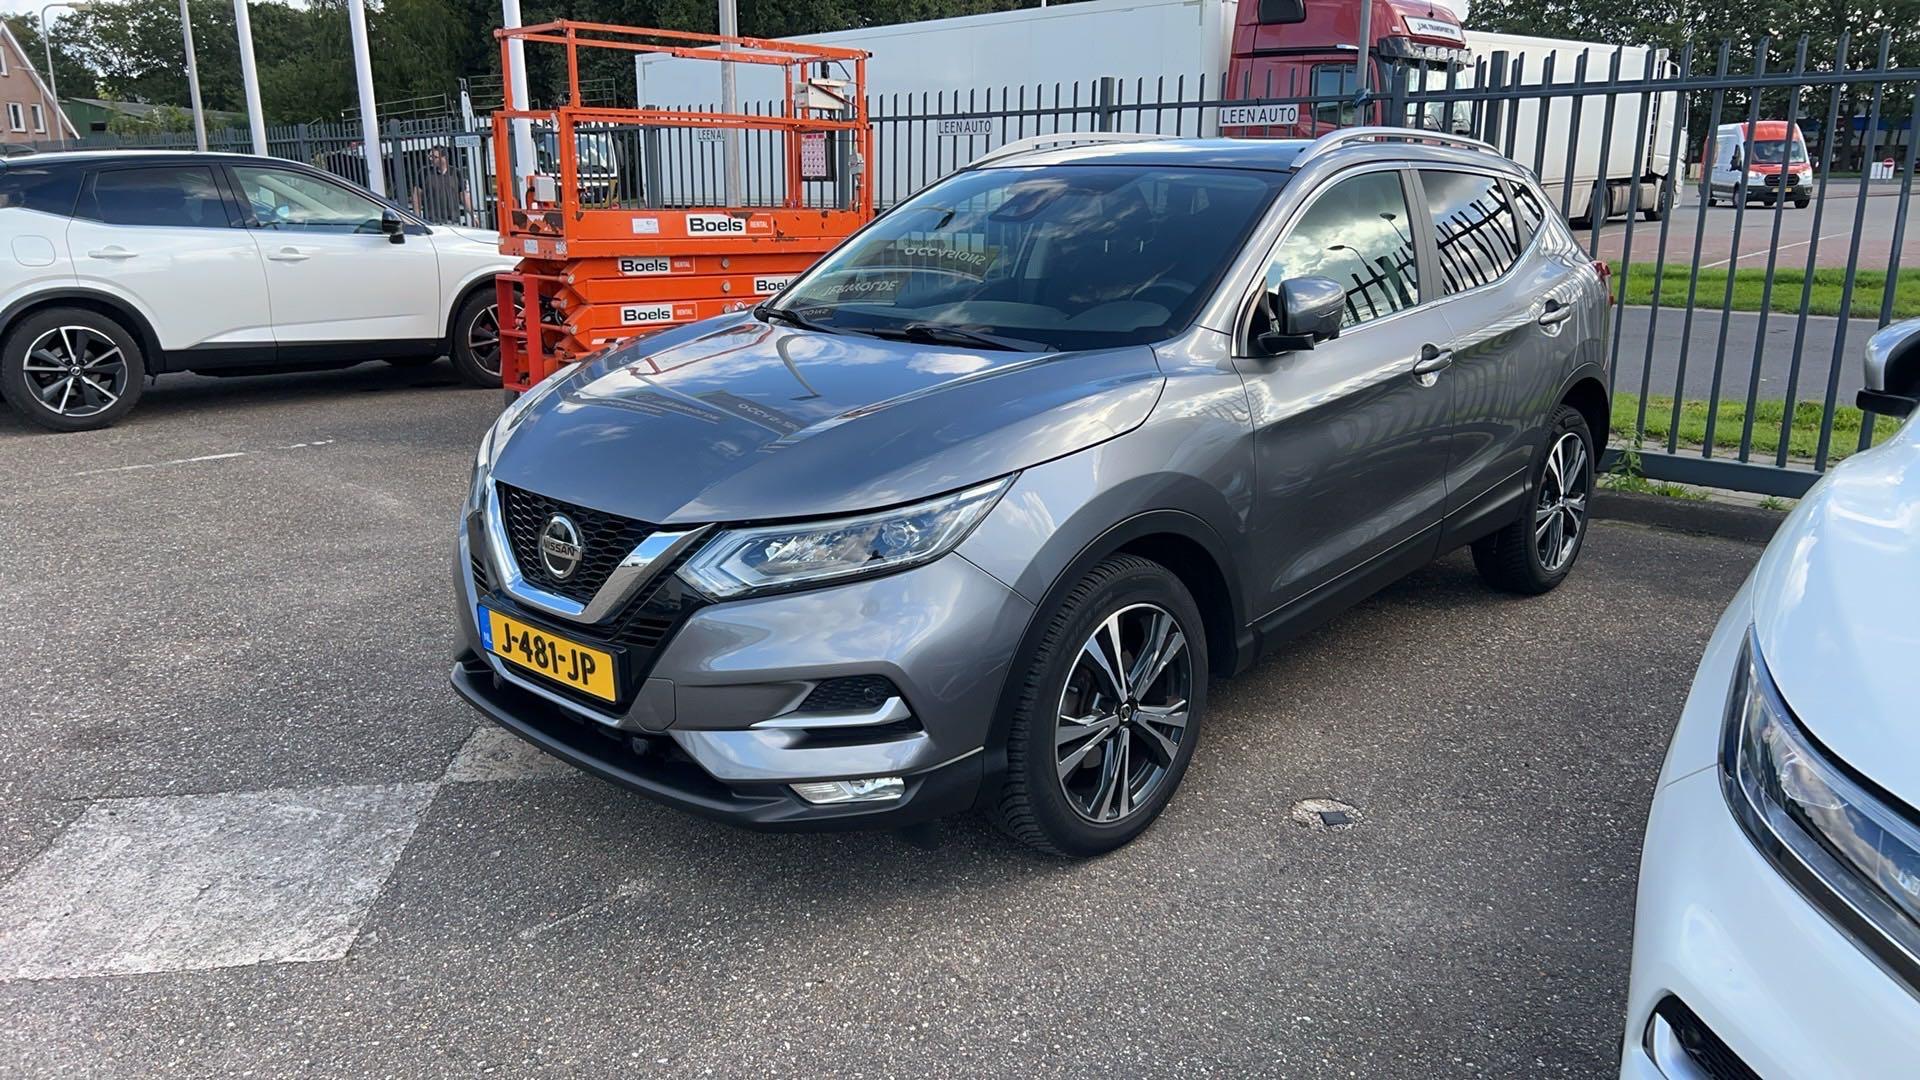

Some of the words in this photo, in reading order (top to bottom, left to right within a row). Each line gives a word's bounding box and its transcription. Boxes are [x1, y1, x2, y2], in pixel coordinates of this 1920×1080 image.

[1221, 107, 1297, 124] LEENAUTO
[938, 120, 991, 134] LEENAUTO
[697, 129, 725, 140] LEENA
[689, 217, 743, 232] Boels
[620, 259, 668, 272] Boels
[756, 279, 788, 291] Boel
[623, 308, 671, 322] Boels
[543, 537, 576, 557] NISSAN
[501, 622, 597, 686] J-481-JP
